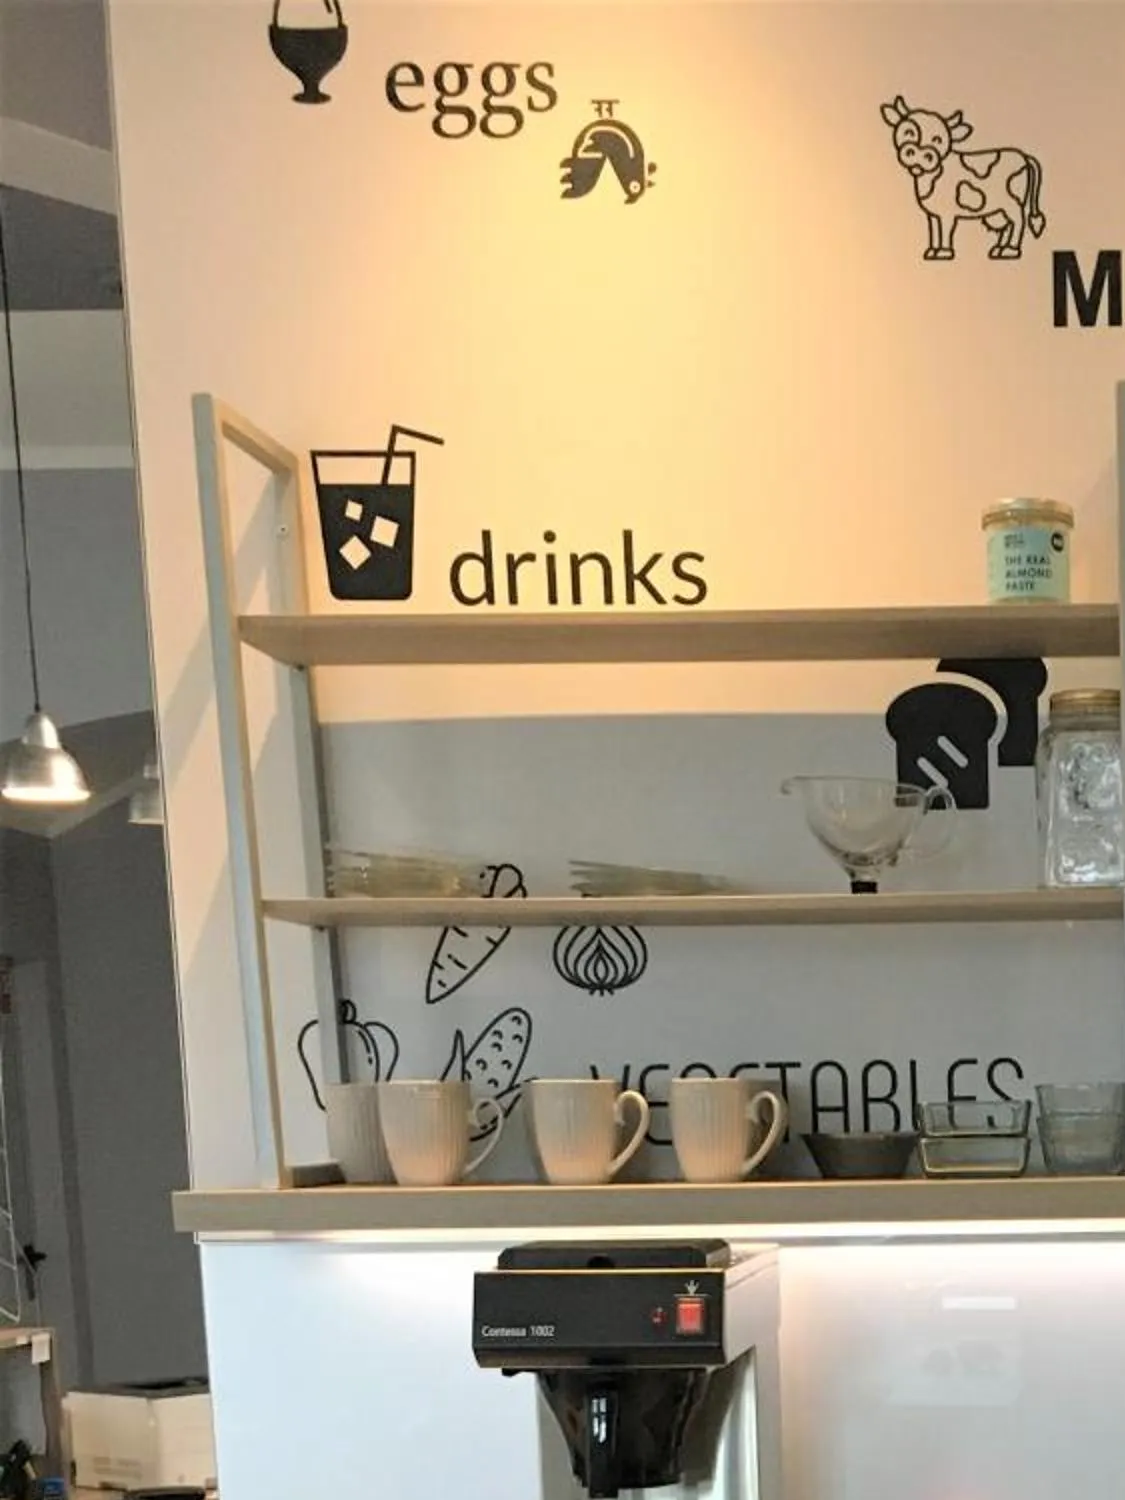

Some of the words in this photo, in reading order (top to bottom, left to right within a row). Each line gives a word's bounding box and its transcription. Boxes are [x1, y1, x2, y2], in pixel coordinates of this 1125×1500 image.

[385, 61, 557, 139] eggs
[449, 529, 707, 606] drinks
[481, 1325, 527, 1337] Contessa
[530, 1325, 555, 1337] 1002
